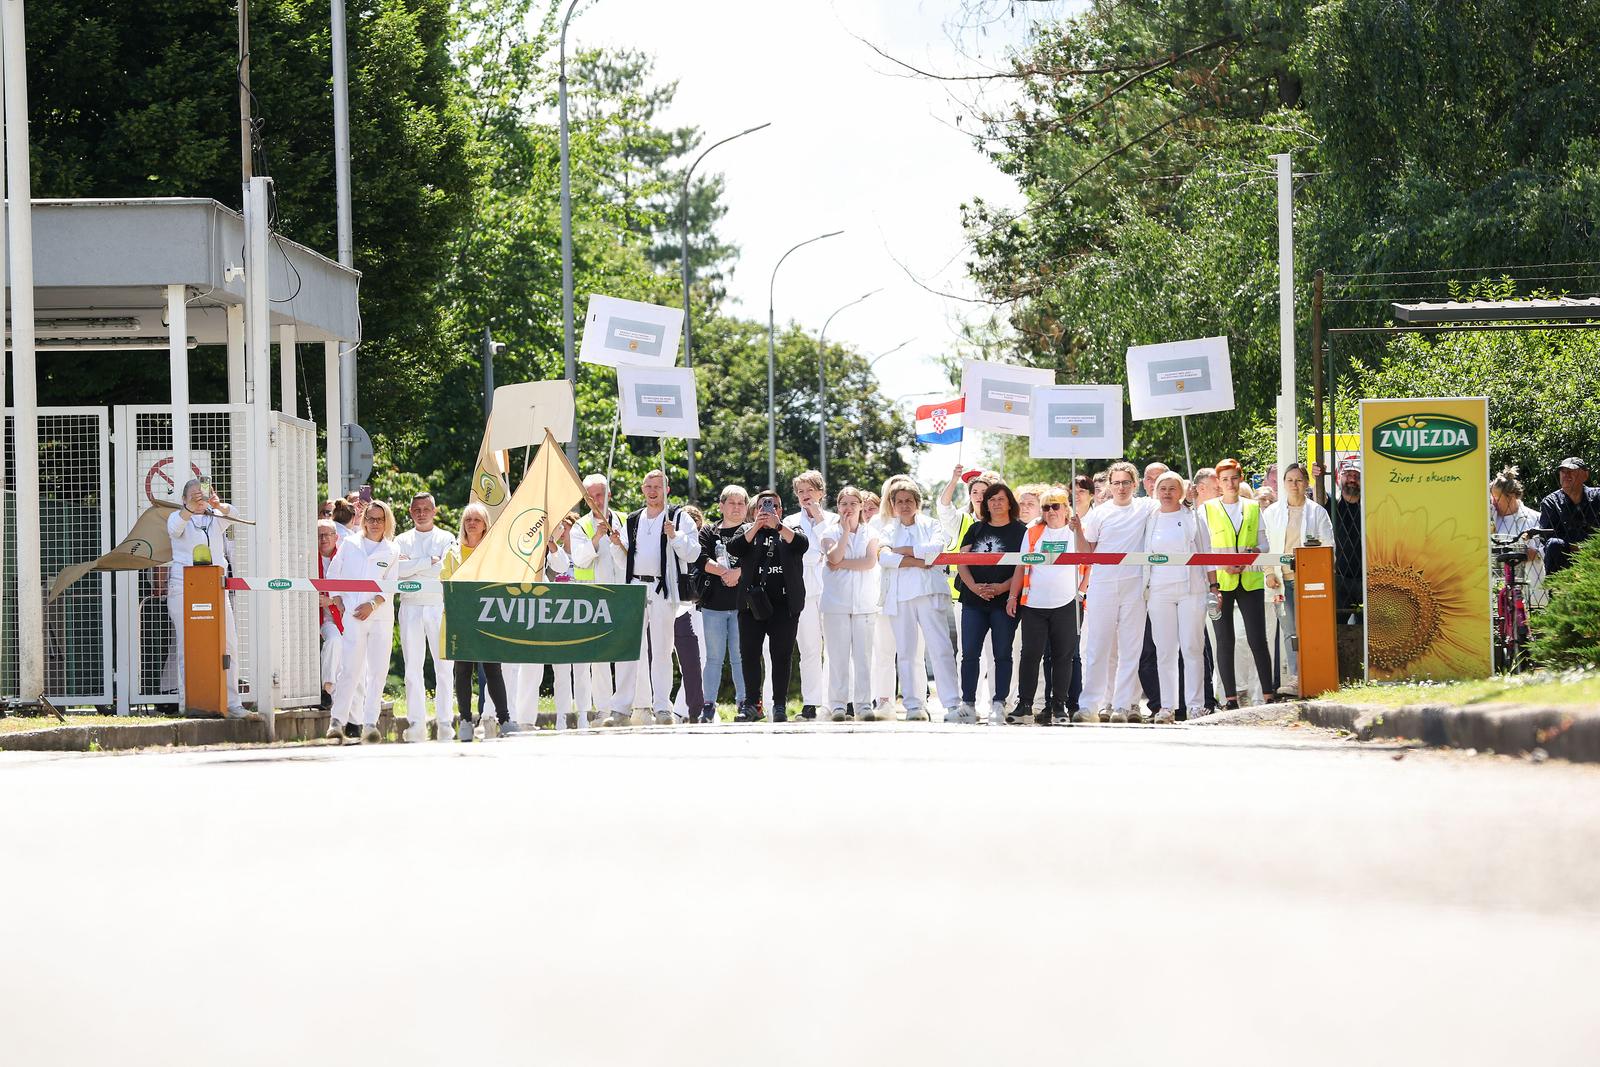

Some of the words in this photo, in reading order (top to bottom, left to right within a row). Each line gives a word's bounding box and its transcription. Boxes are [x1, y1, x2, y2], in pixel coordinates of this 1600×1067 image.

[1379, 428, 1470, 451] ZVIJEZDA
[1390, 468, 1414, 483] Život
[1418, 475, 1424, 483] s
[1426, 471, 1462, 483] okusom
[477, 596, 613, 631] ZVIJEZDA
